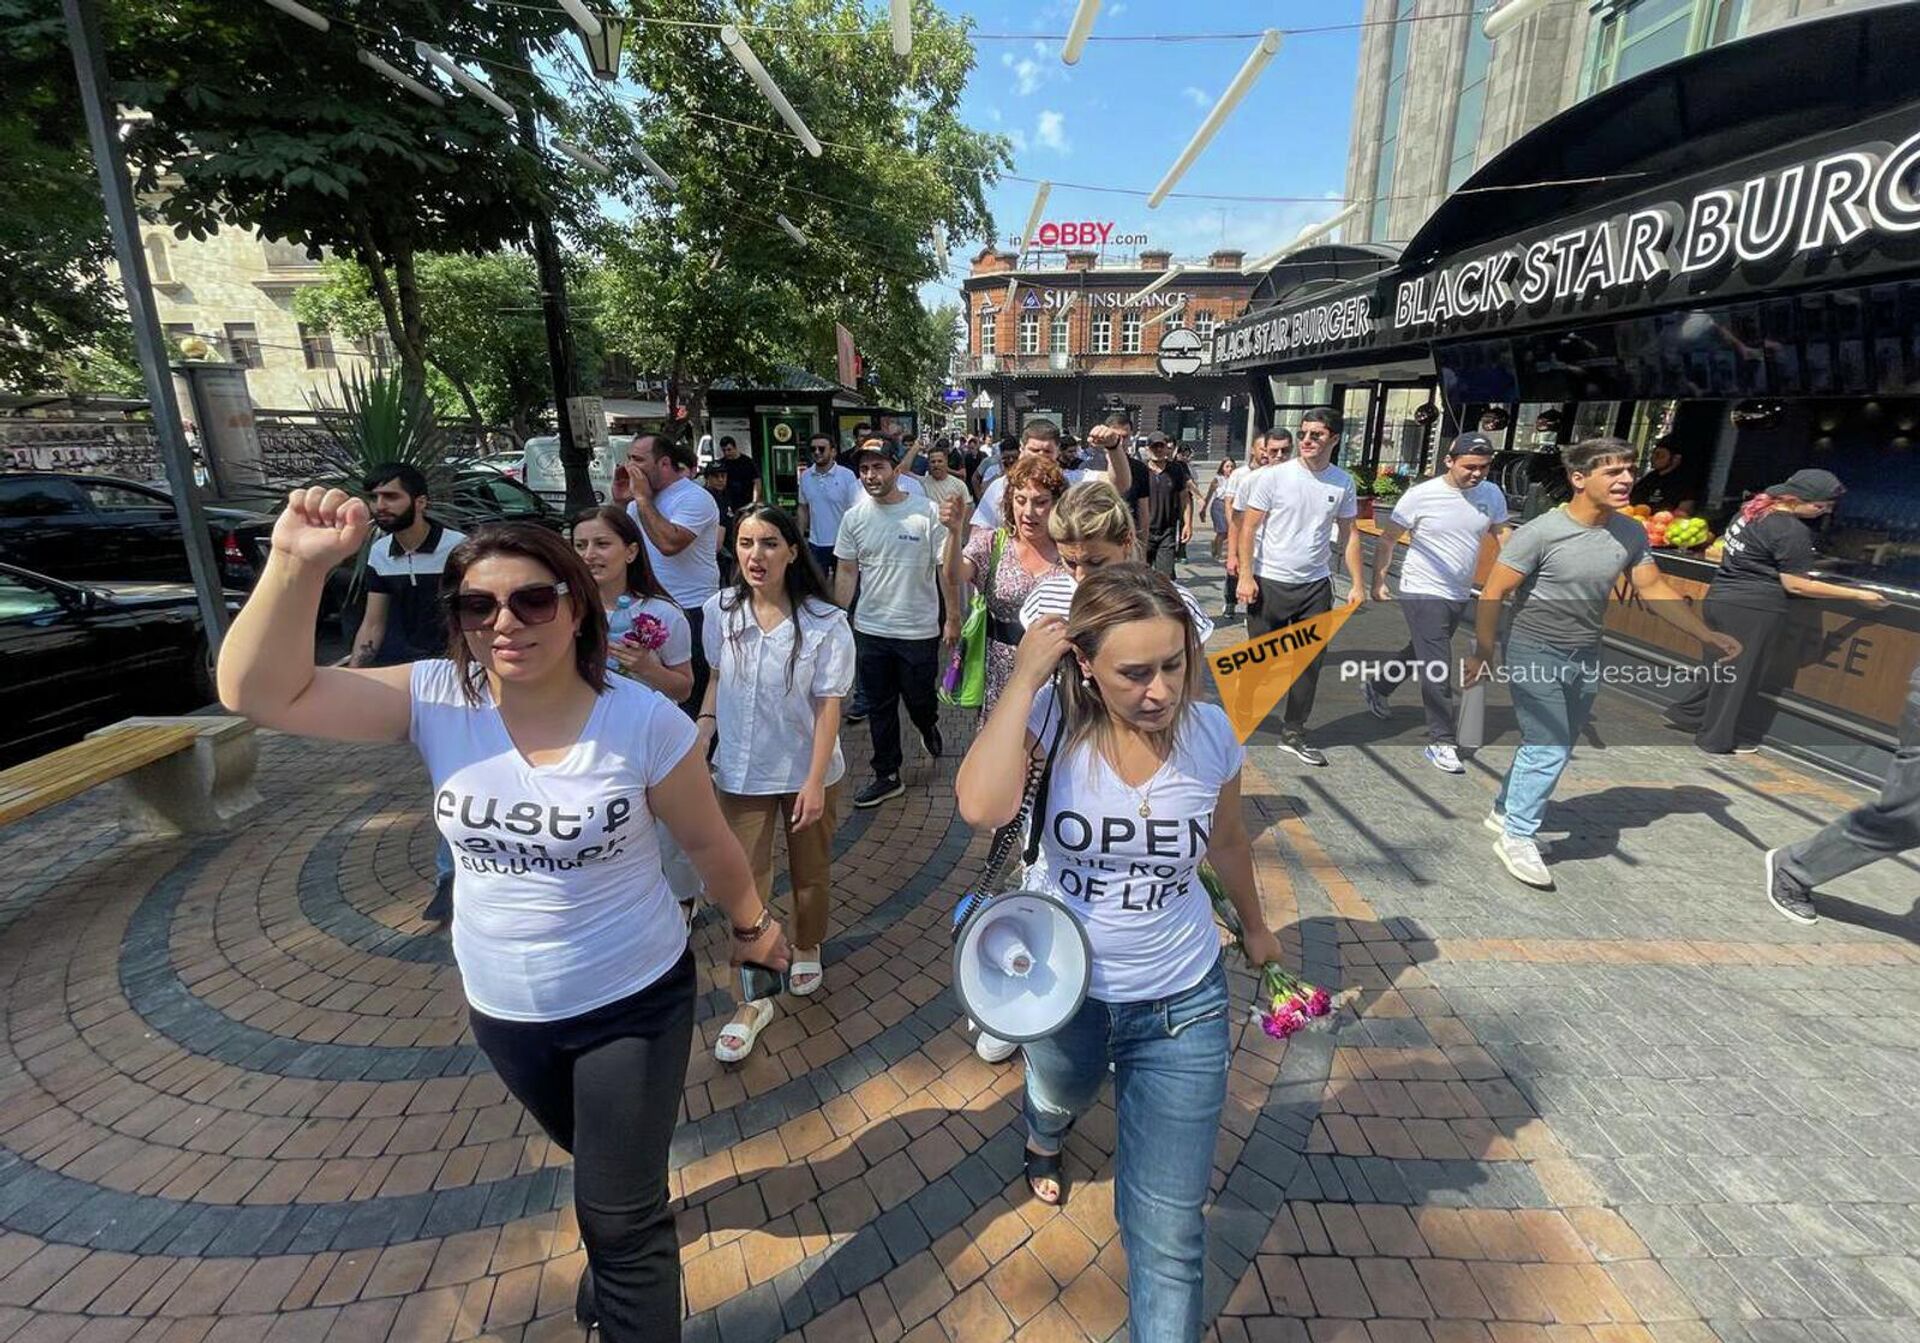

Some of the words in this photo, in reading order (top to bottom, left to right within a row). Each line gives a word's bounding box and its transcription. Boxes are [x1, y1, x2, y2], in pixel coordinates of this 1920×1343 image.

[1395, 251, 1512, 328] BLACK
[1520, 209, 1667, 303] STAR
[1216, 325, 1253, 363] BLACK
[1253, 317, 1290, 356] STAR
[1291, 295, 1371, 348] BURGER
[1054, 810, 1213, 858] OPEN
[1059, 868, 1108, 902] OF
[1122, 880, 1190, 911] LIFE
